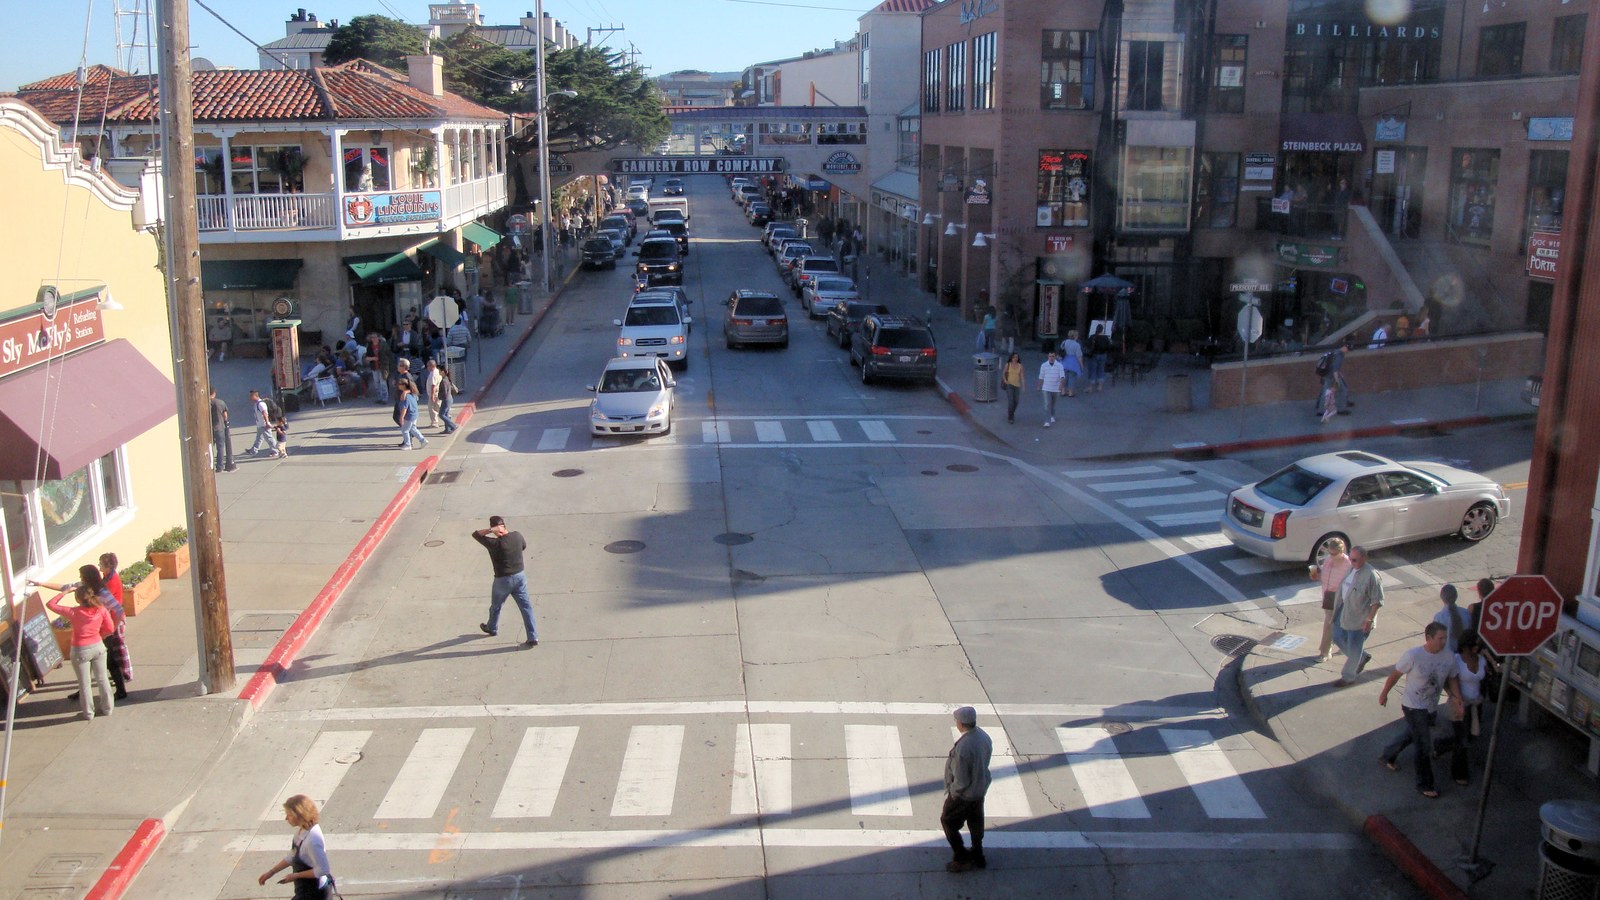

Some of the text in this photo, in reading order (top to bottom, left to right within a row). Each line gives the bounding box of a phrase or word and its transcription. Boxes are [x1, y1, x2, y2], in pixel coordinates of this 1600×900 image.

[1296, 23, 1439, 38] BILLIARDS
[1283, 141, 1362, 152] STEINBECK PLAZA
[622, 159, 775, 172] CANNERY ROW COMPANY
[391, 193, 424, 205] LOUIE
[377, 202, 439, 216] LINGUINI'S
[1053, 241, 1067, 251] TV
[1532, 239, 1545, 247] DOC
[75, 326, 94, 339] Station
[2, 322, 72, 364] Sly McFly's
[1485, 601, 1556, 631] STOP
